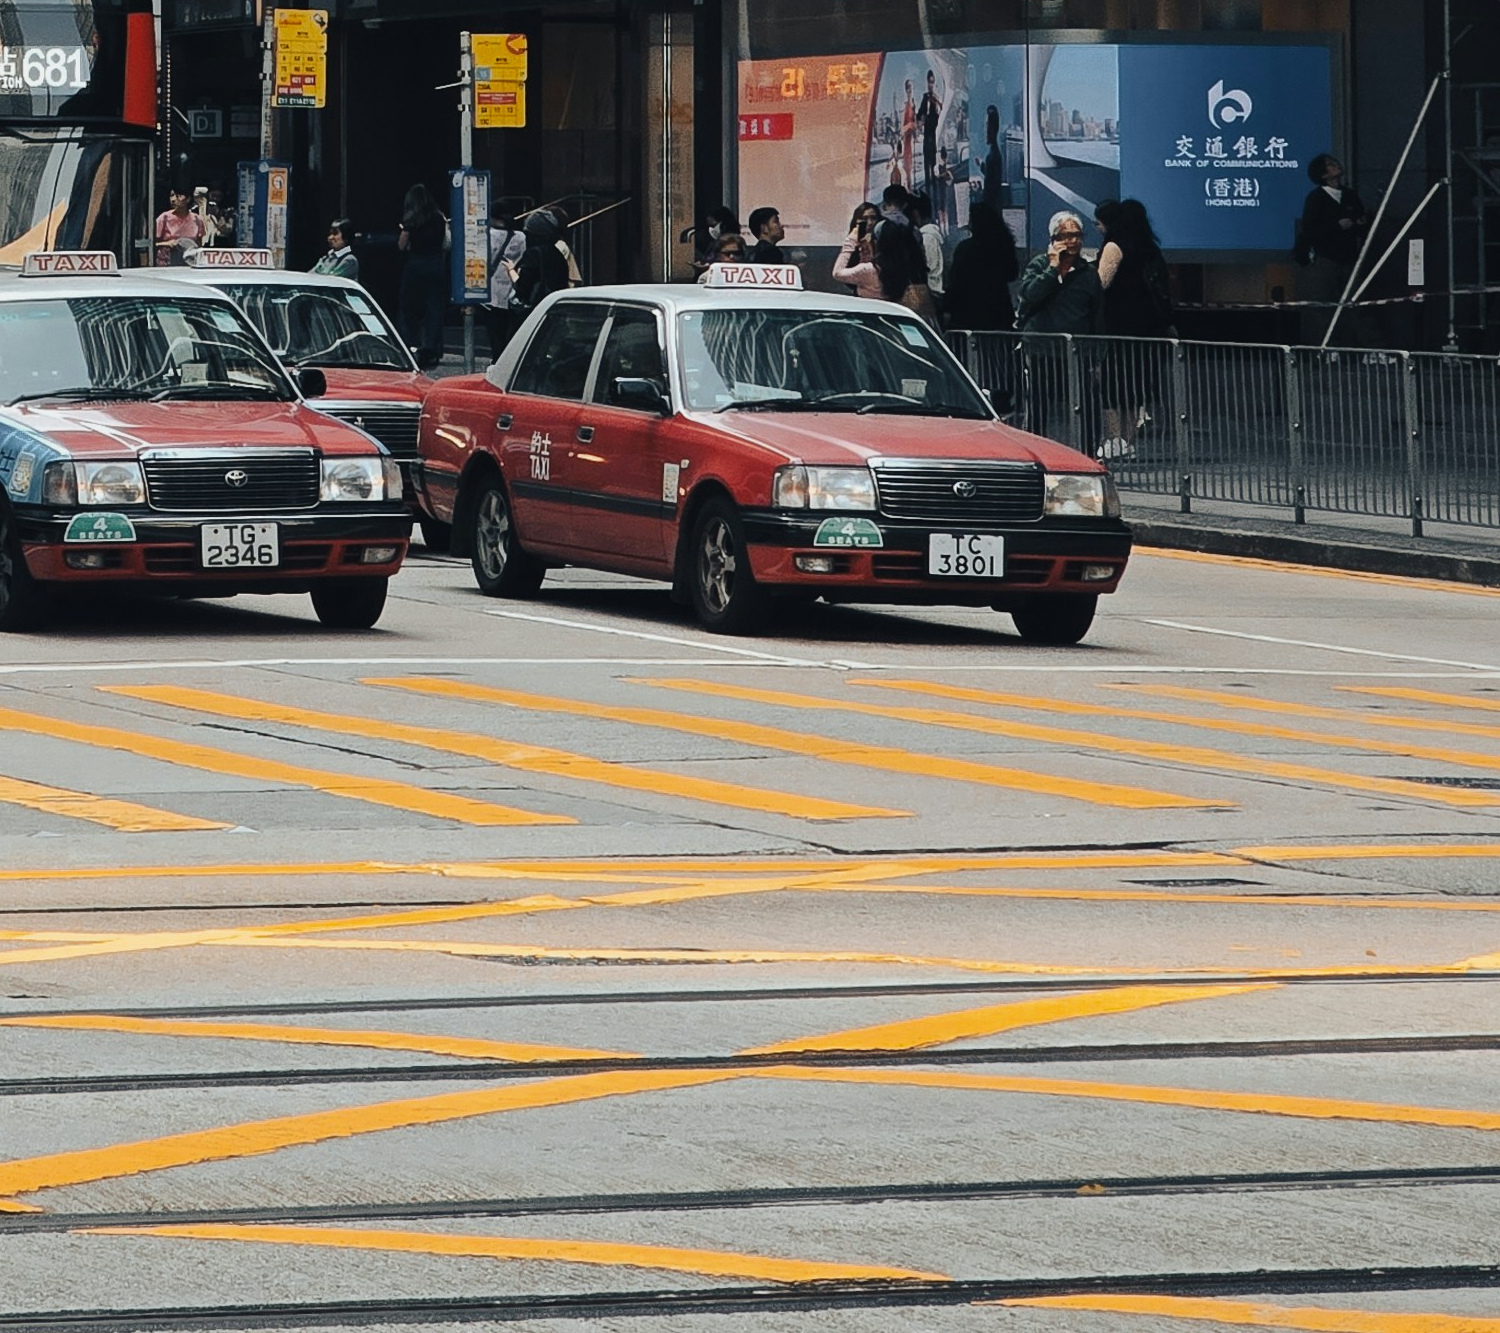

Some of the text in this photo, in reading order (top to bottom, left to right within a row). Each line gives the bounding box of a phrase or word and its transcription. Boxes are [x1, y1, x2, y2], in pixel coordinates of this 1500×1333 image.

[22, 48, 87, 88] 681
[1175, 135, 1289, 159] 交通銀行
[1213, 160, 1298, 168] COMMUNICATIONS
[1204, 178, 1260, 198] (香港)
[34, 254, 111, 271] TAXI
[204, 251, 268, 265] TAXI
[721, 267, 795, 285] TAXI
[530, 430, 551, 456] 的士
[530, 455, 550, 481] TAXI
[93, 517, 108, 531] 4
[840, 522, 856, 536] 4
[80, 531, 121, 540] SEATS
[223, 525, 256, 546] TG
[828, 536, 869, 544] SEATS
[952, 535, 981, 554] TC
[207, 545, 273, 565] 2346
[938, 555, 994, 576] 3801
